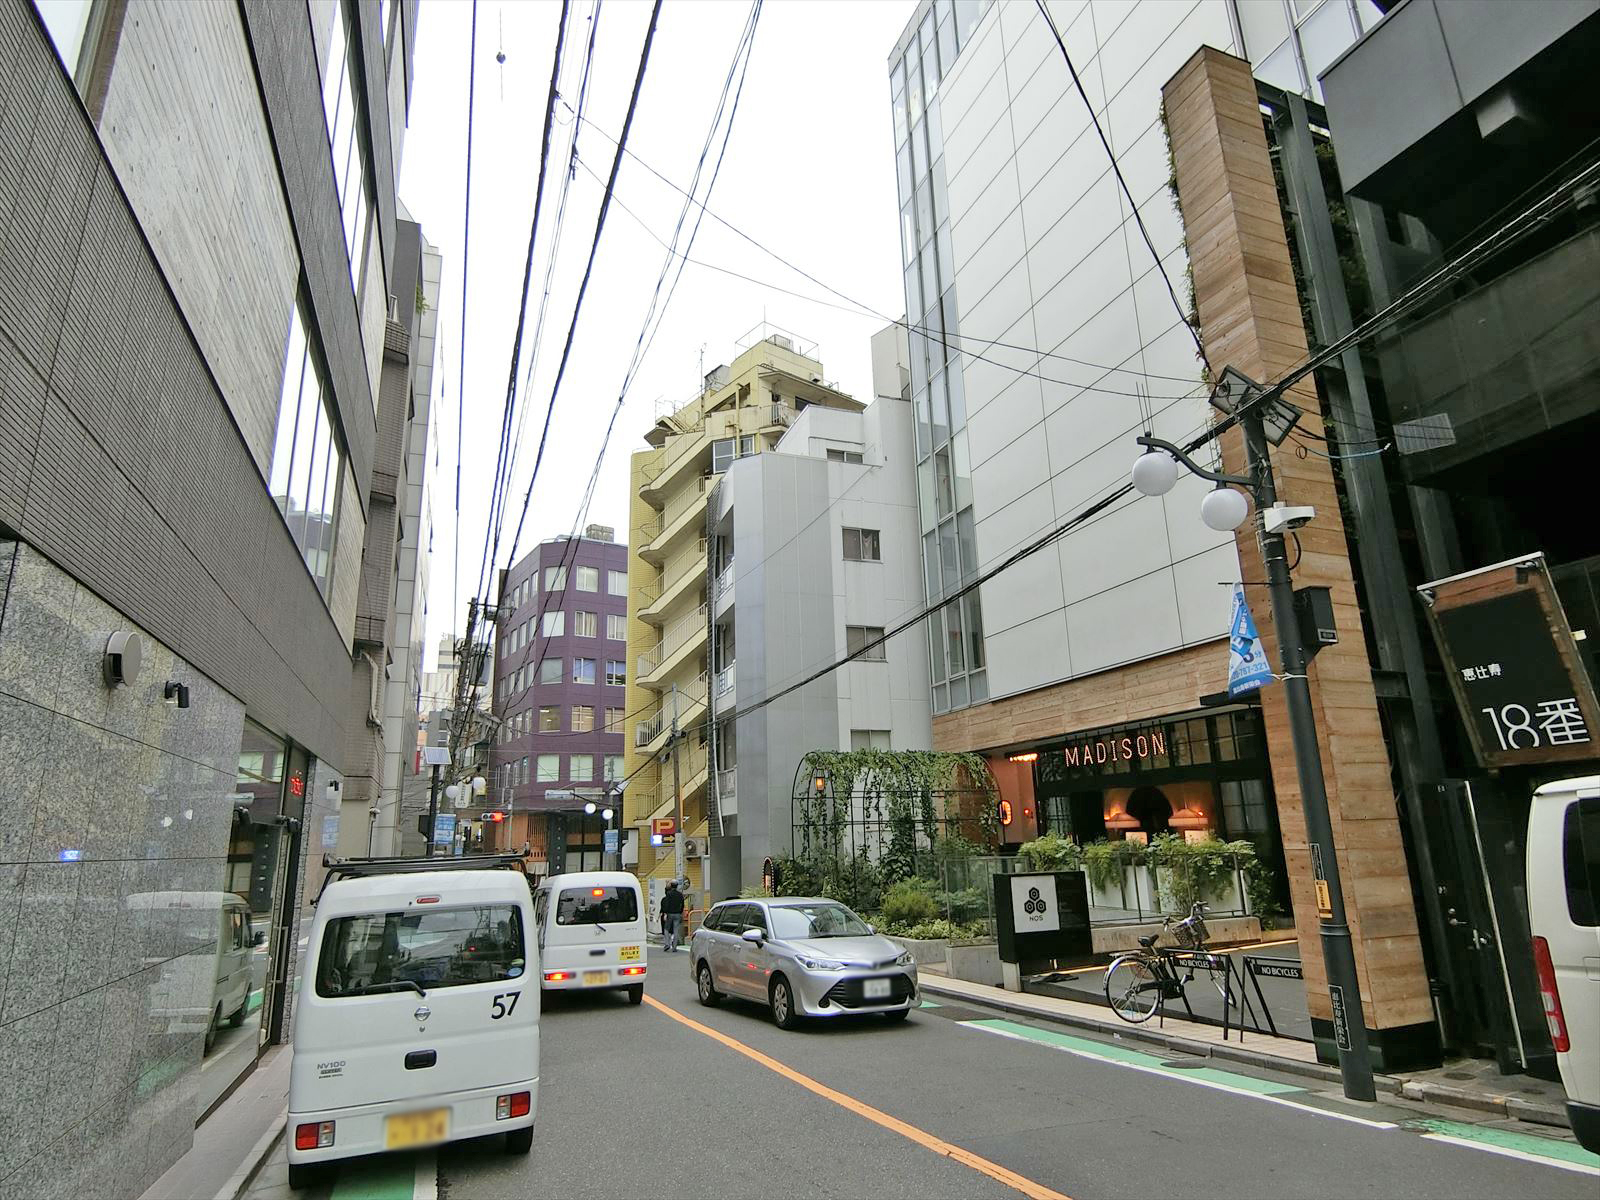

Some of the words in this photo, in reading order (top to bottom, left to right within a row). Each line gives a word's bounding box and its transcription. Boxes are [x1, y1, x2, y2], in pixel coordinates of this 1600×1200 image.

[1461, 664, 1501, 681] 恵比寿
[1482, 698, 1590, 750] 18番
[1065, 733, 1166, 767] MADISON
[656, 820, 674, 834] P
[1261, 967, 1271, 975] NO
[1272, 967, 1299, 977] BICYCLES
[491, 991, 522, 1020] 57
[317, 1061, 346, 1070] NV100
